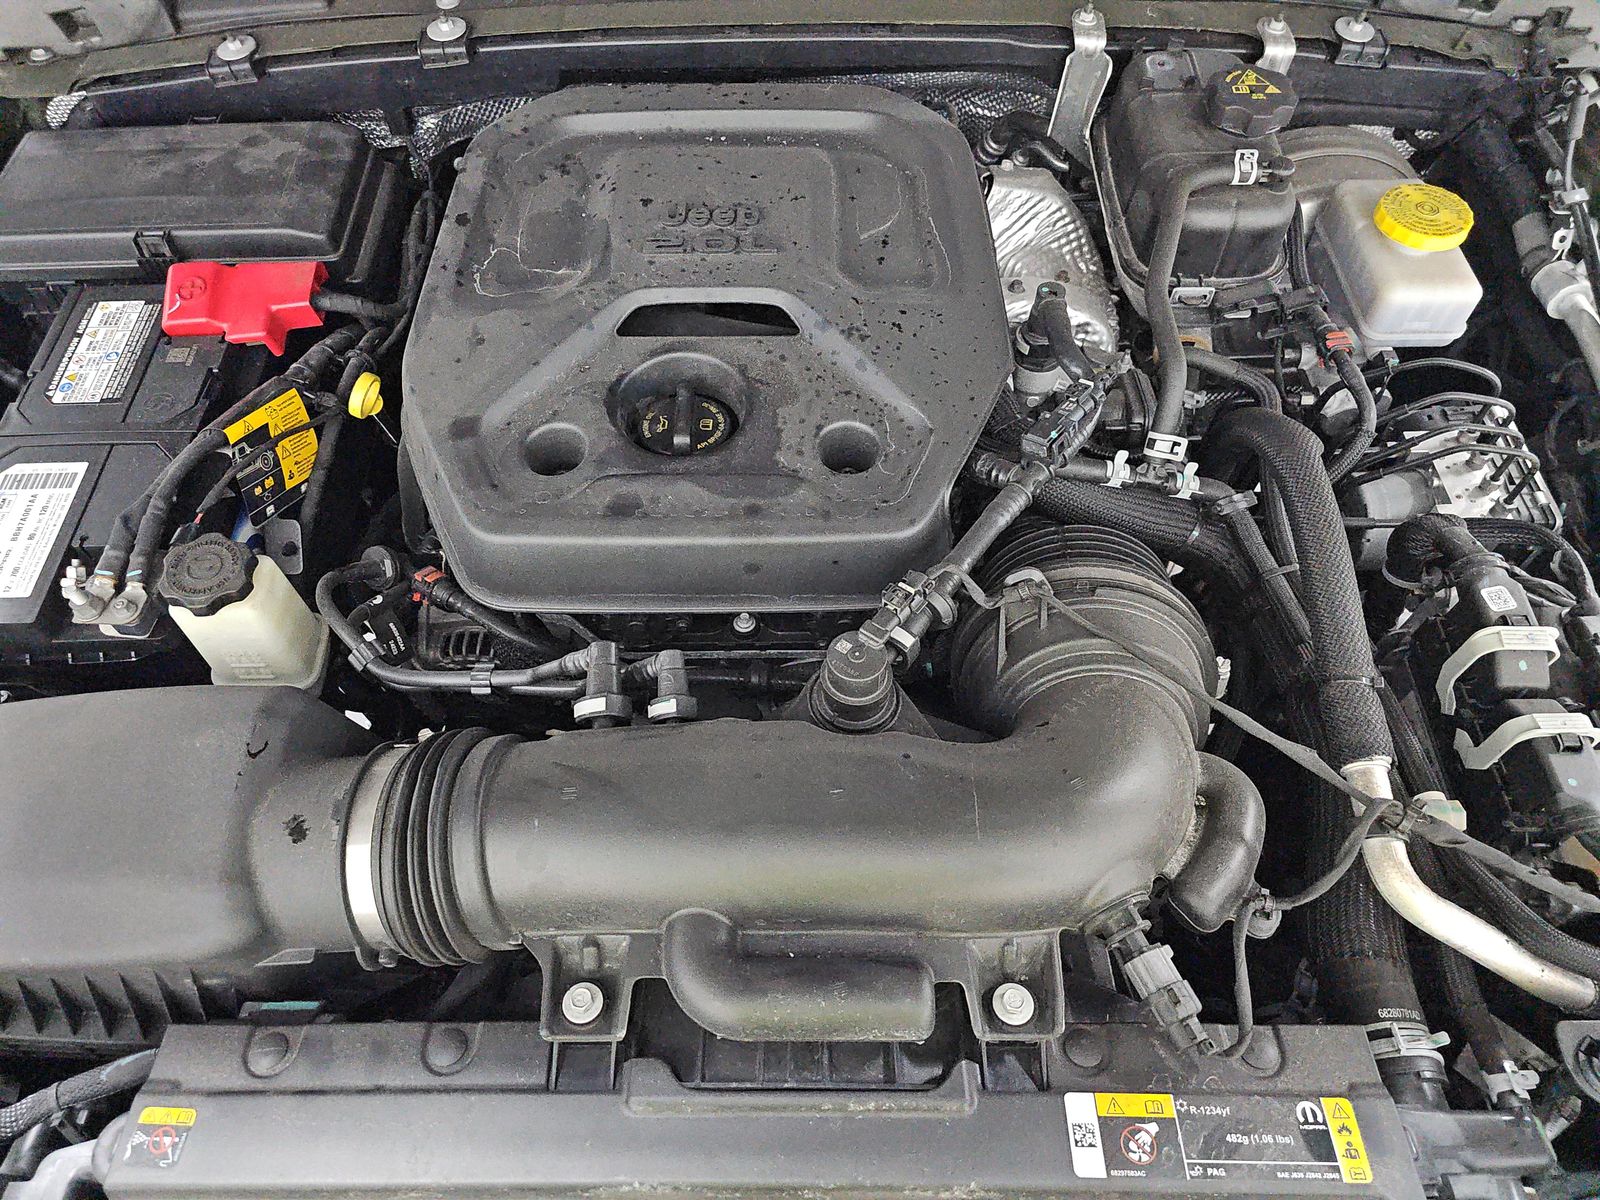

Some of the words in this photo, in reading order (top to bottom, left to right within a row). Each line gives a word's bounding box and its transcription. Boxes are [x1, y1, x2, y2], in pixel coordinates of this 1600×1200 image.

[660, 204, 764, 231] Jeep
[696, 441, 709, 450] API
[1189, 1104, 1231, 1118] R-1234yf
[1225, 1133, 1249, 1145] 482g
[1250, 1133, 1272, 1145] (1.06
[1273, 1134, 1294, 1146] lbs)
[1206, 1167, 1226, 1177] PAG
